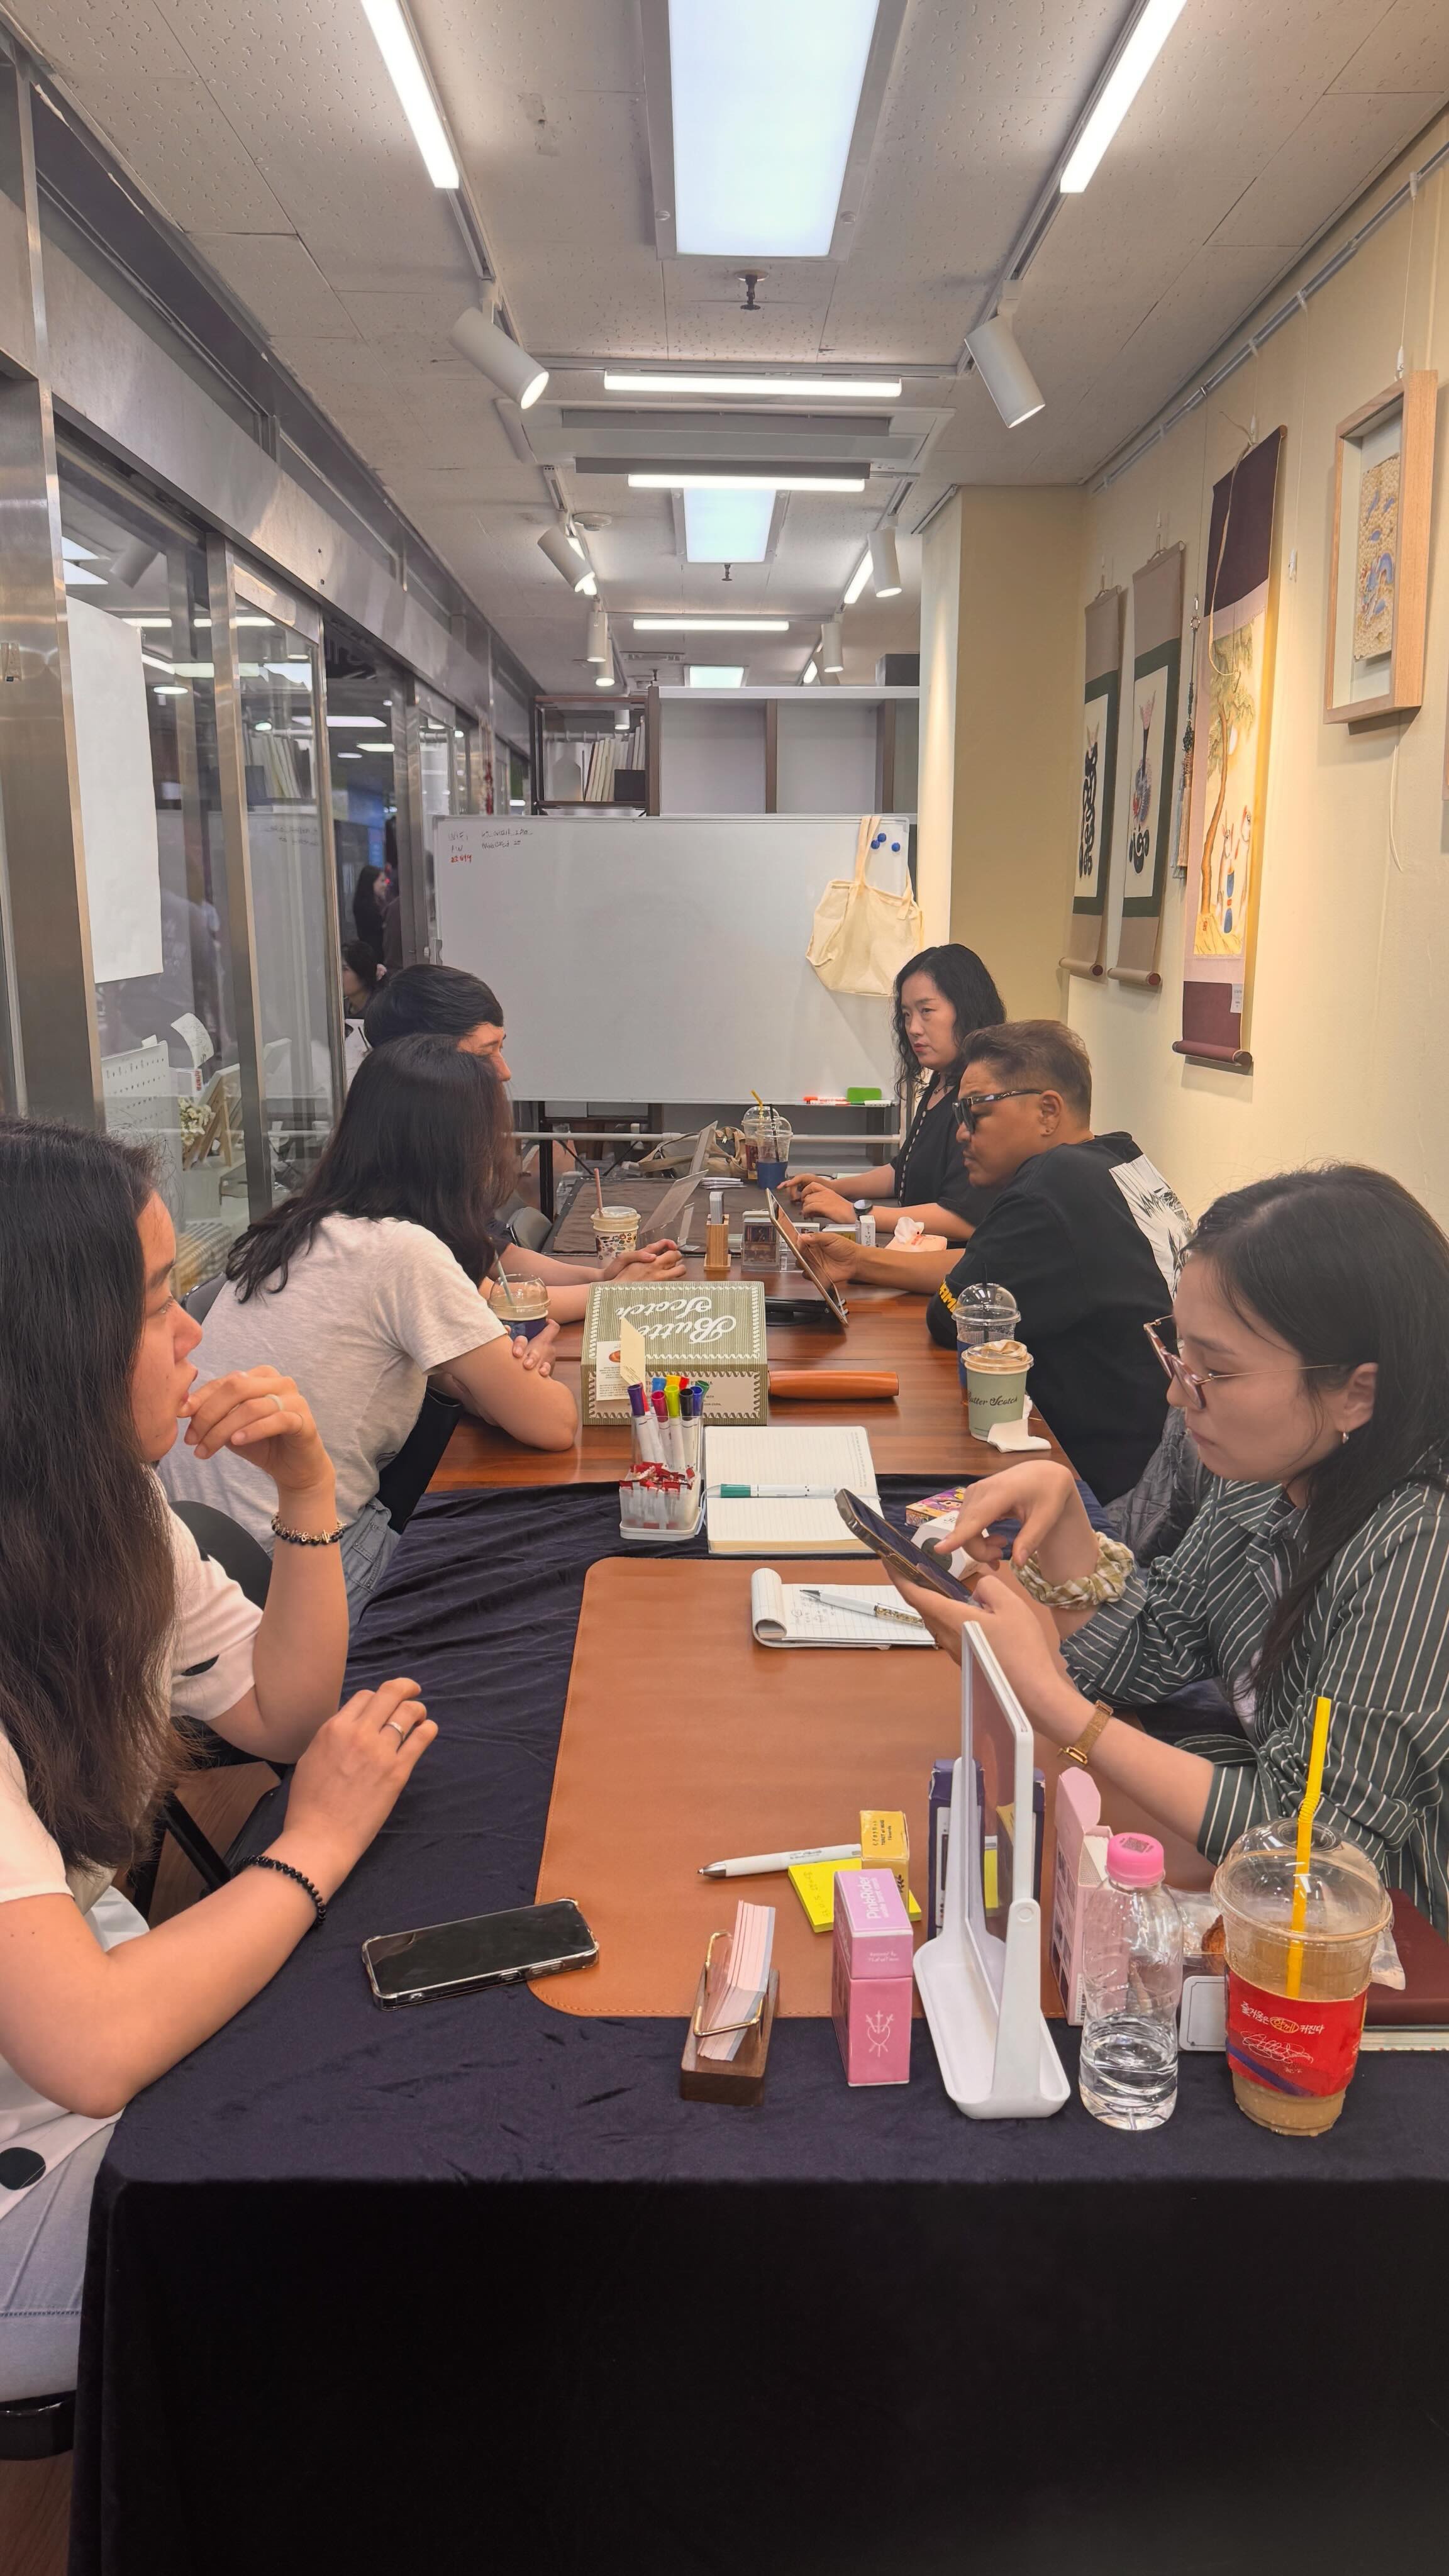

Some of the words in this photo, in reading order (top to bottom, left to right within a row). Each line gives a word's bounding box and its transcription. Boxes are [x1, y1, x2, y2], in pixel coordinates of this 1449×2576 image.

[616, 1296, 712, 1319] Scotch
[637, 1315, 736, 1344] Butte
[858, 1877, 882, 1919] PinkRider
[1241, 2001, 1269, 2025] 즐거움은
[1274, 2017, 1296, 2033] 함께
[1300, 2024, 1324, 2035] 커진다
